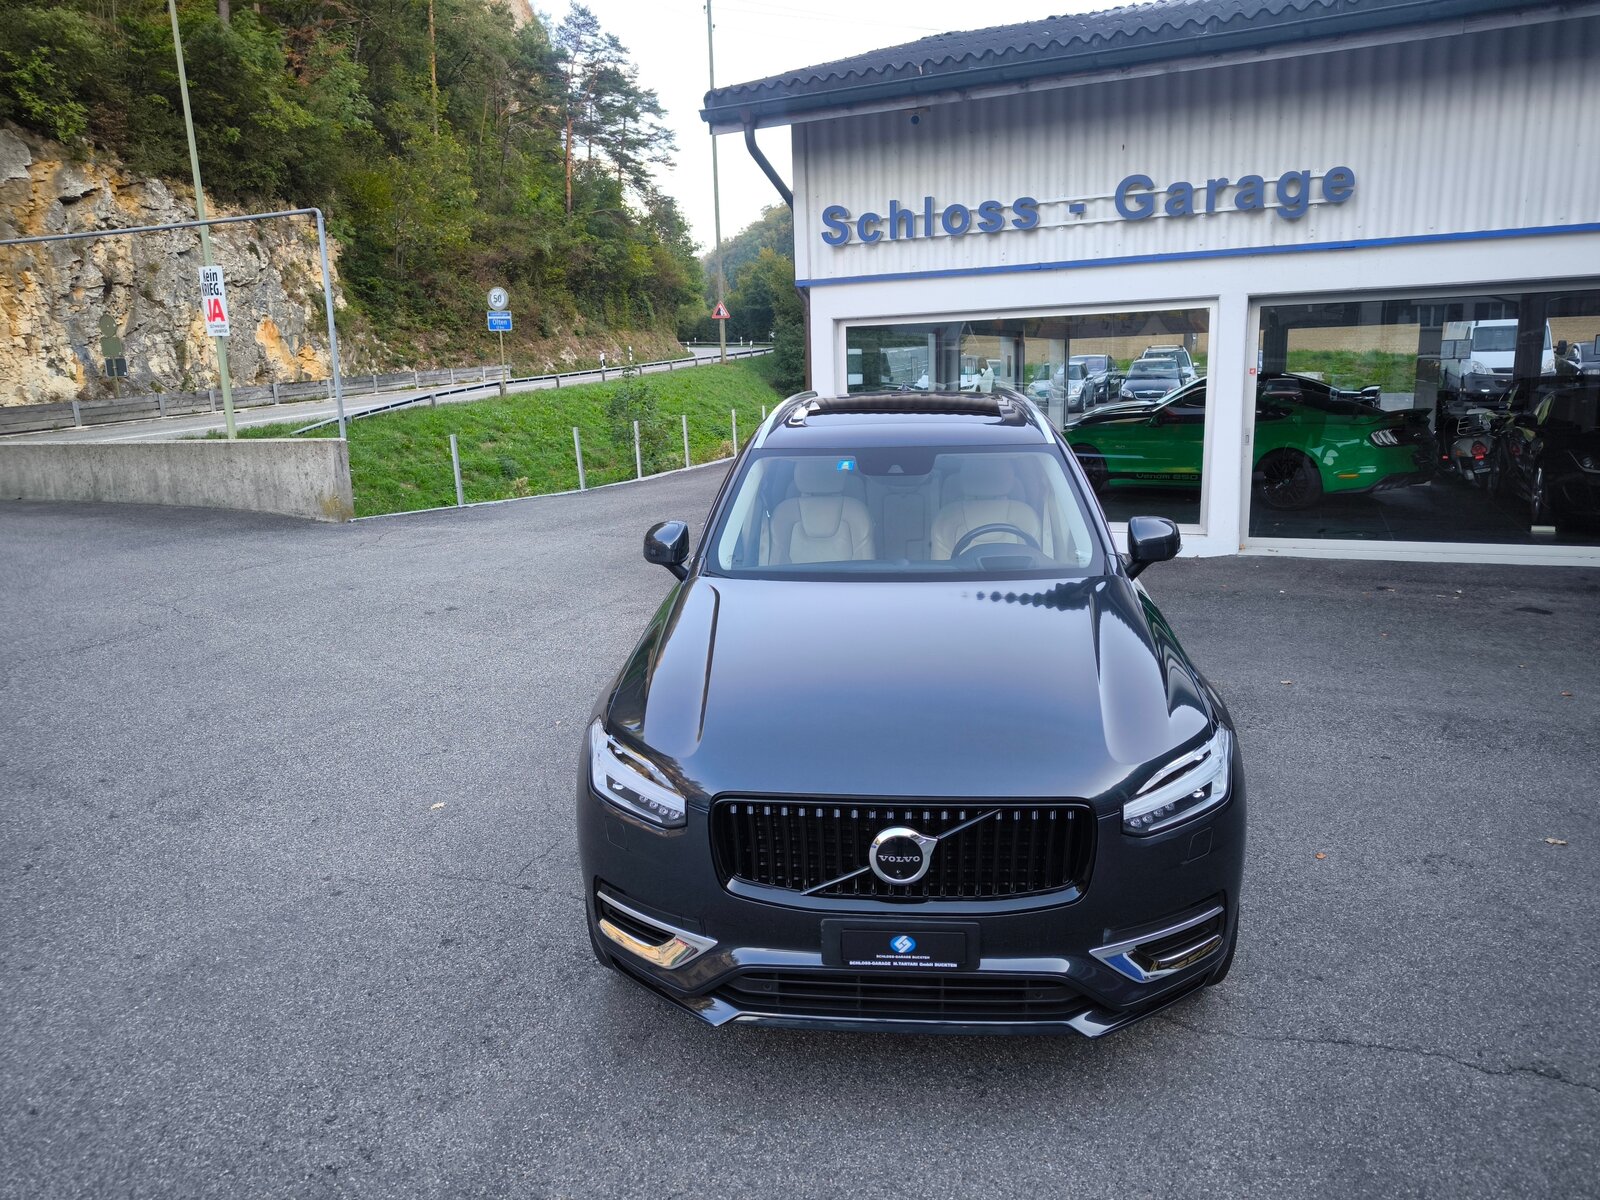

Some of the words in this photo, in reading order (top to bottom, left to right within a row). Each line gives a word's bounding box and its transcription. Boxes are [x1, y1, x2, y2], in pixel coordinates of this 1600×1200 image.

[821, 196, 1040, 247] Schloss
[1114, 165, 1355, 220] Garage
[207, 298, 225, 322] JA
[493, 294, 502, 303] 50
